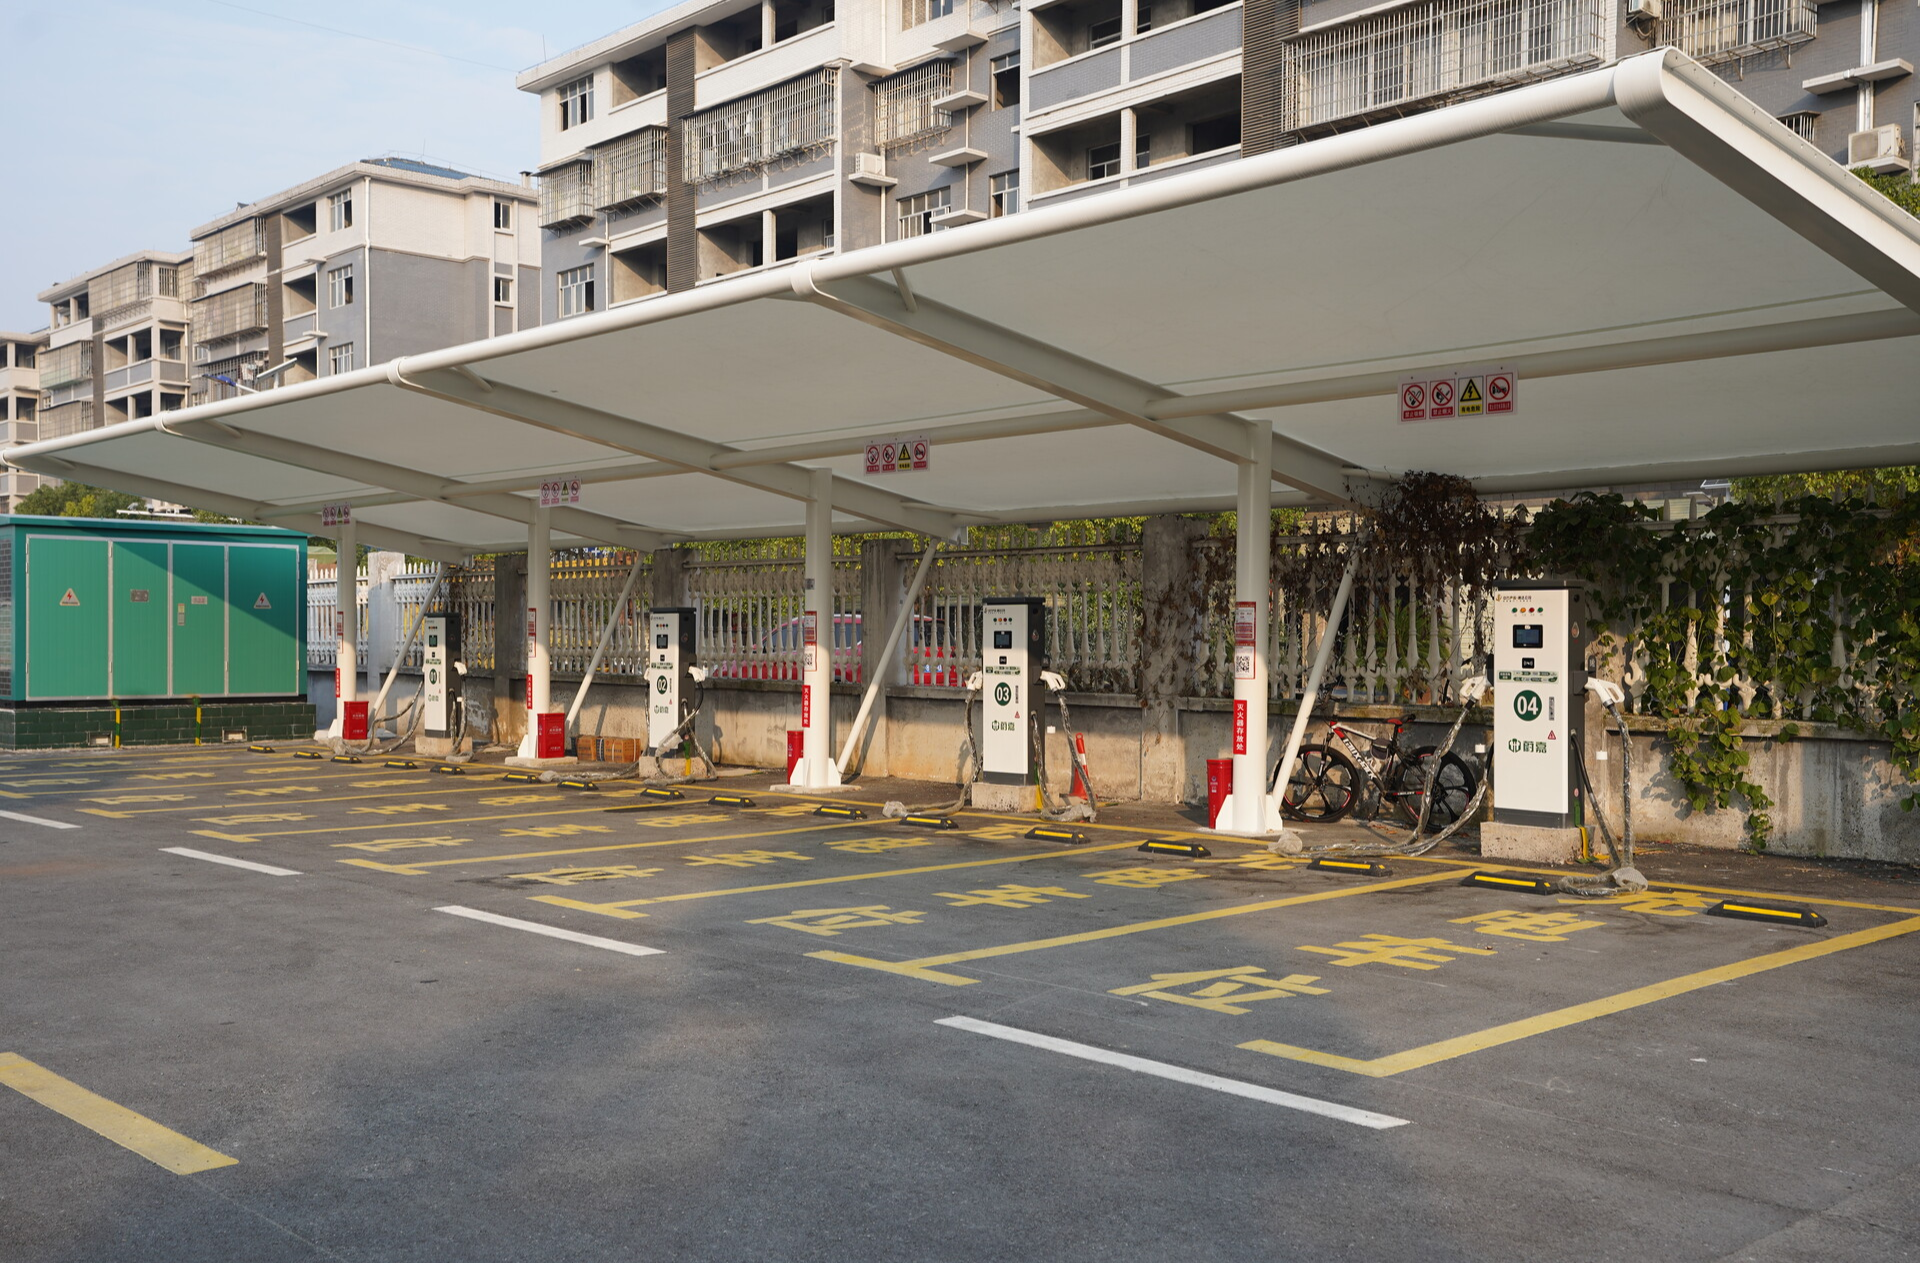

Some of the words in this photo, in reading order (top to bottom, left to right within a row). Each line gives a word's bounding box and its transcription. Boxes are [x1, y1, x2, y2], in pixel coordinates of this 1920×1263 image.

[657, 679, 667, 691] 02
[996, 686, 1010, 702] 03
[1516, 695, 1539, 716] 04
[1236, 703, 1244, 751] 灭火器存放处
[1107, 890, 1723, 1015] 充电车位
